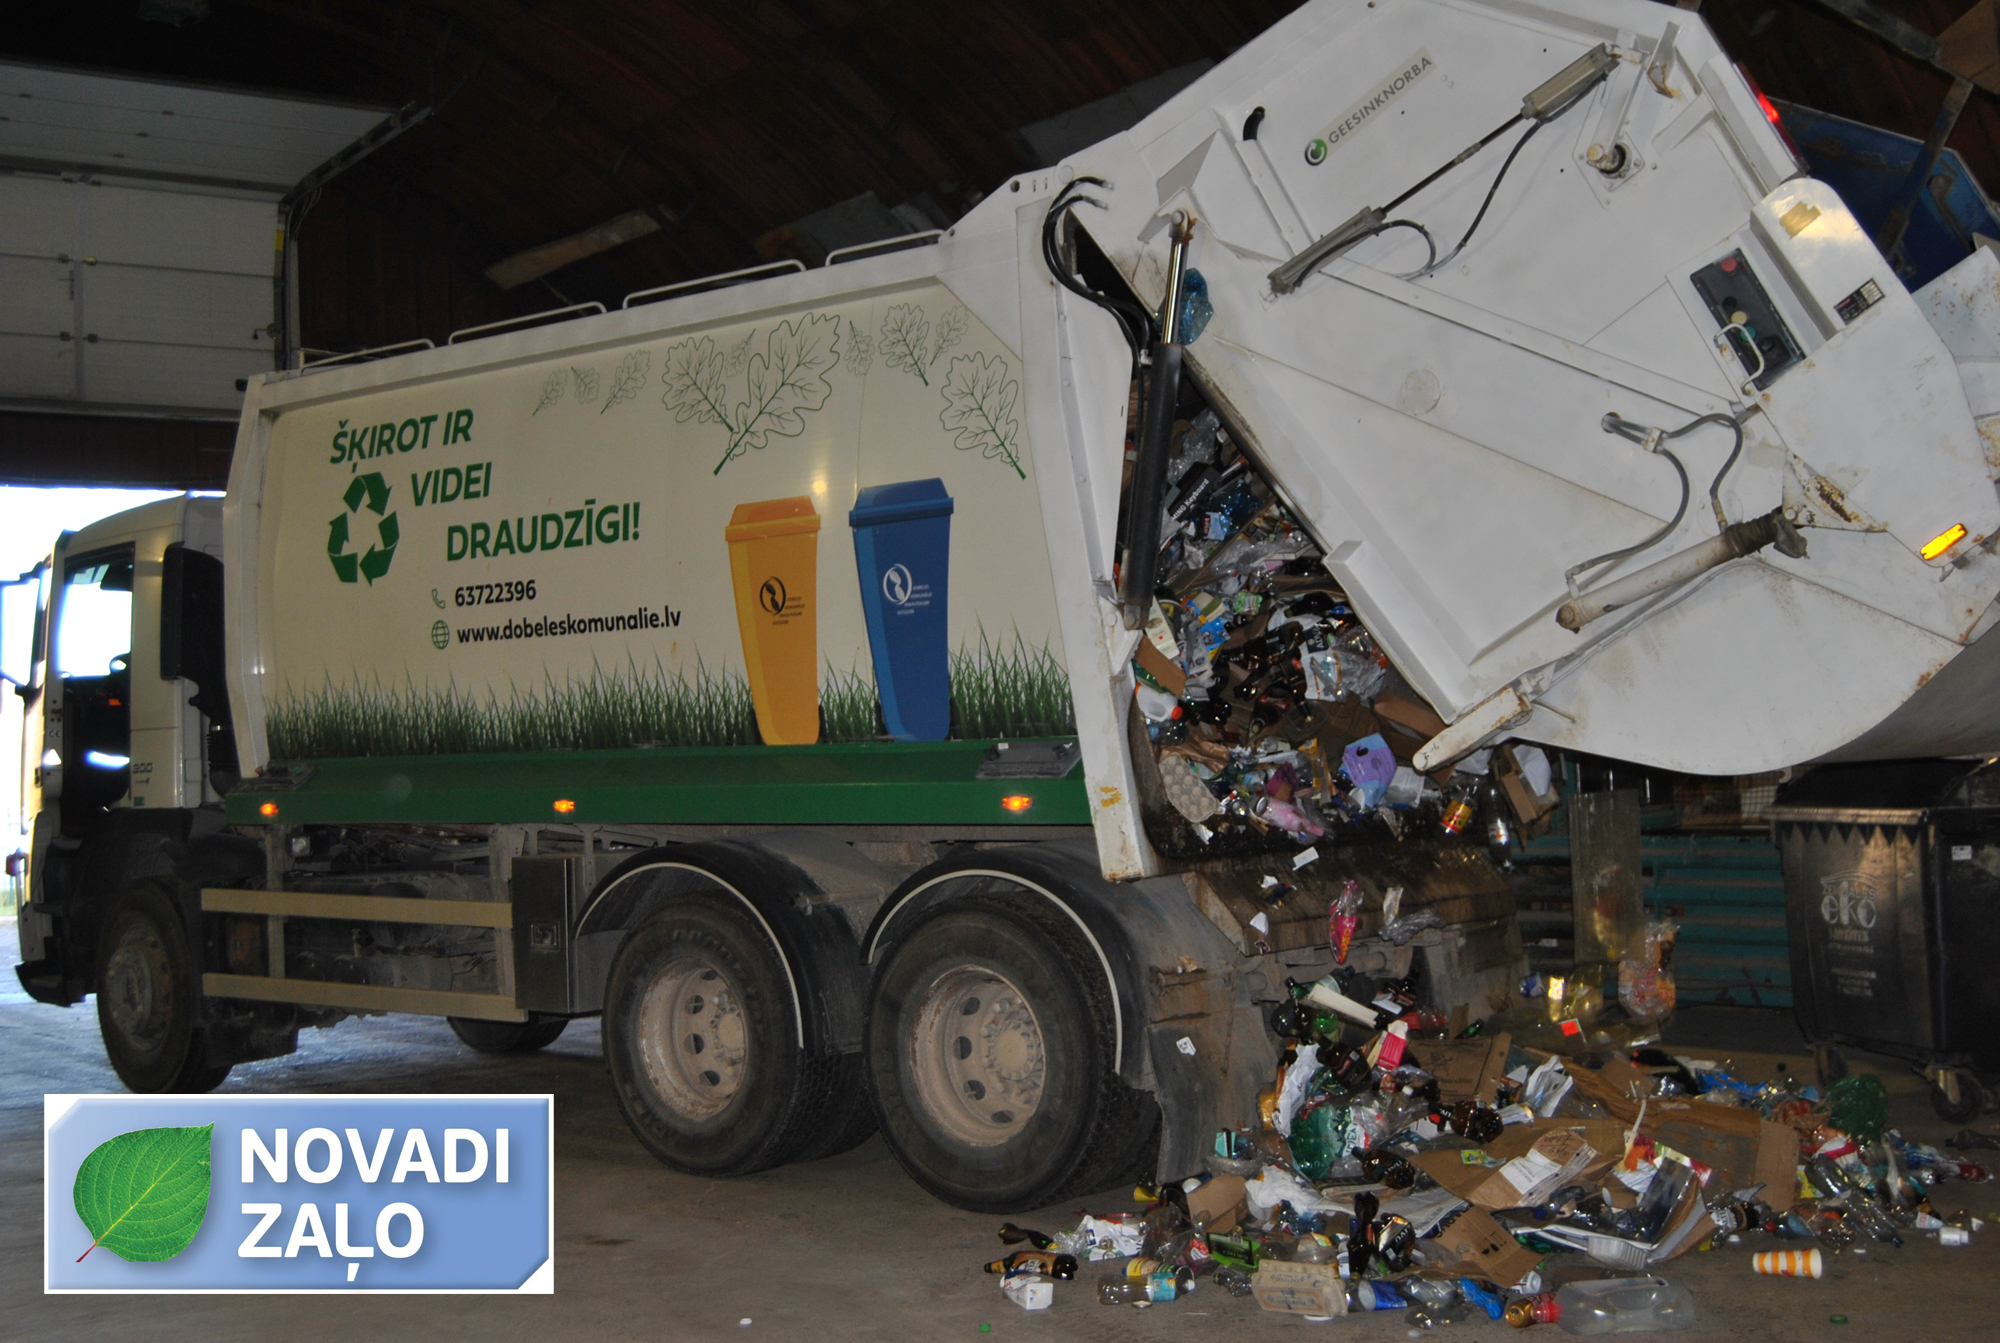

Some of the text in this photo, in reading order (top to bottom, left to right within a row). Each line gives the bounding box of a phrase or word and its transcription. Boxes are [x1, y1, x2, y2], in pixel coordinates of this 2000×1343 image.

[1328, 56, 1433, 144] GEESINKNORBA
[330, 408, 475, 473] ŠĶIROT IR
[411, 461, 493, 506] VIDEI
[1184, 477, 1210, 508] Keyboard
[446, 498, 641, 562] DRAUDZĪGI!
[454, 579, 537, 607] 63722396
[456, 605, 681, 644] www.dobeleskomunalie.lv
[1820, 881, 1877, 928] eko
